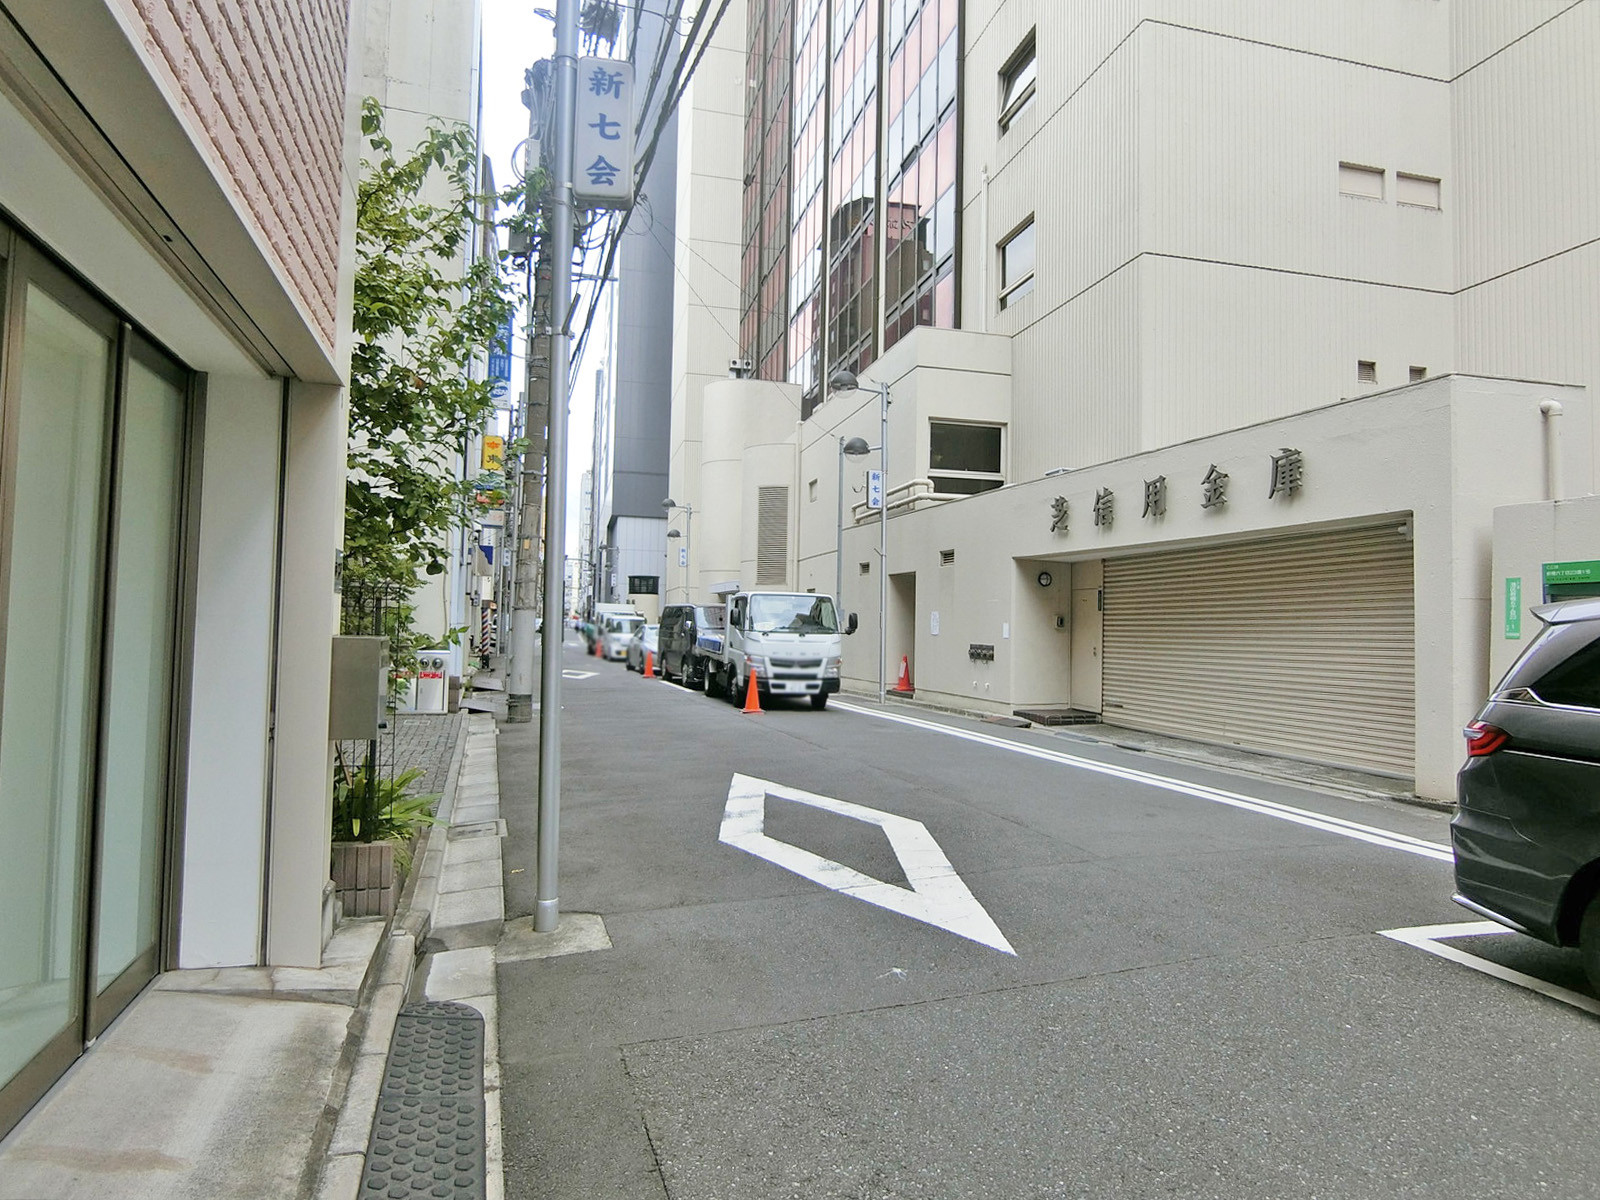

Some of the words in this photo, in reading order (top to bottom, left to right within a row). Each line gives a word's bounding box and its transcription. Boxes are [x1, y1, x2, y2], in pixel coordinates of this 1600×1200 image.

[585, 66, 625, 186] 新七会
[872, 472, 880, 506] 新七会
[1050, 447, 1303, 533] 芝信用金庫
